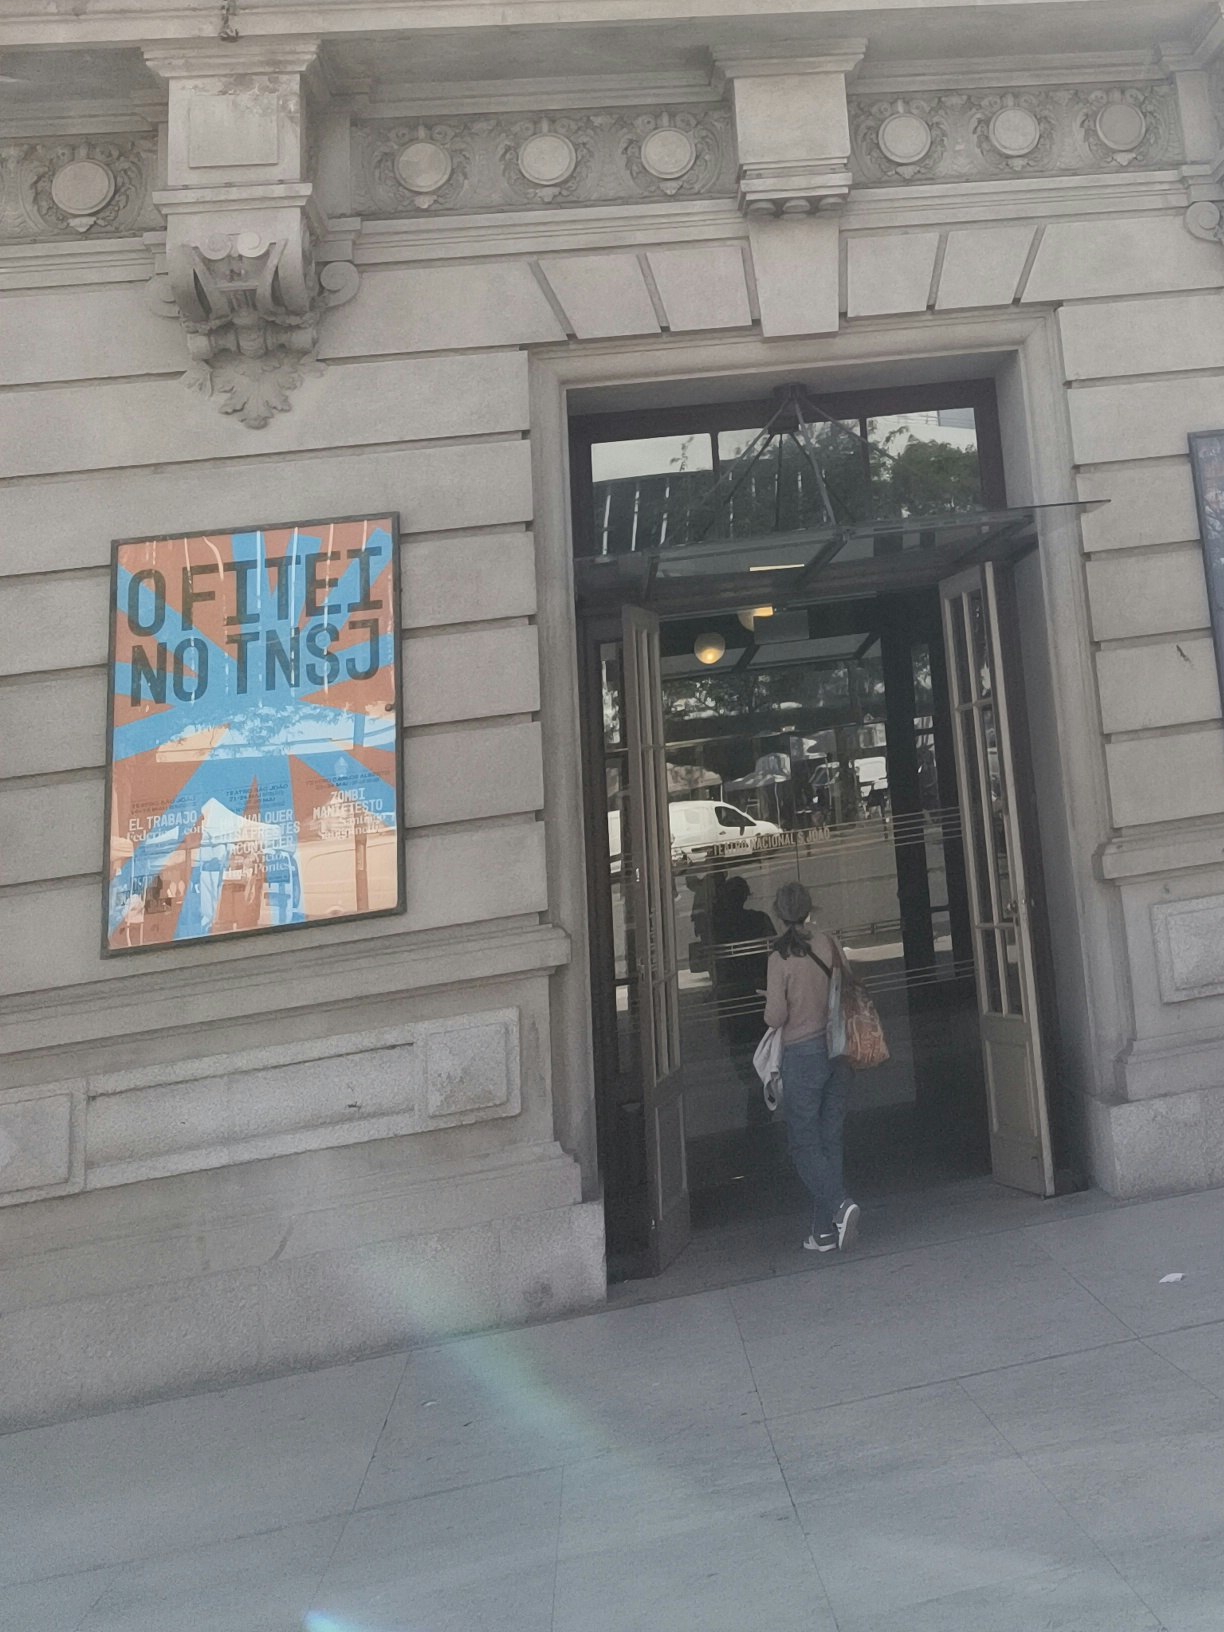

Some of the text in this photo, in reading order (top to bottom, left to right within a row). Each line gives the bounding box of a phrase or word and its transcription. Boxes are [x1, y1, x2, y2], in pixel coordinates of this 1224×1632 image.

[127, 545, 383, 637] O FITEI
[131, 618, 380, 707] NO TNSJ
[330, 787, 366, 804] ZOMBI
[129, 810, 197, 831] EL TRABAJO
[750, 832, 796, 850] NACIONAL
